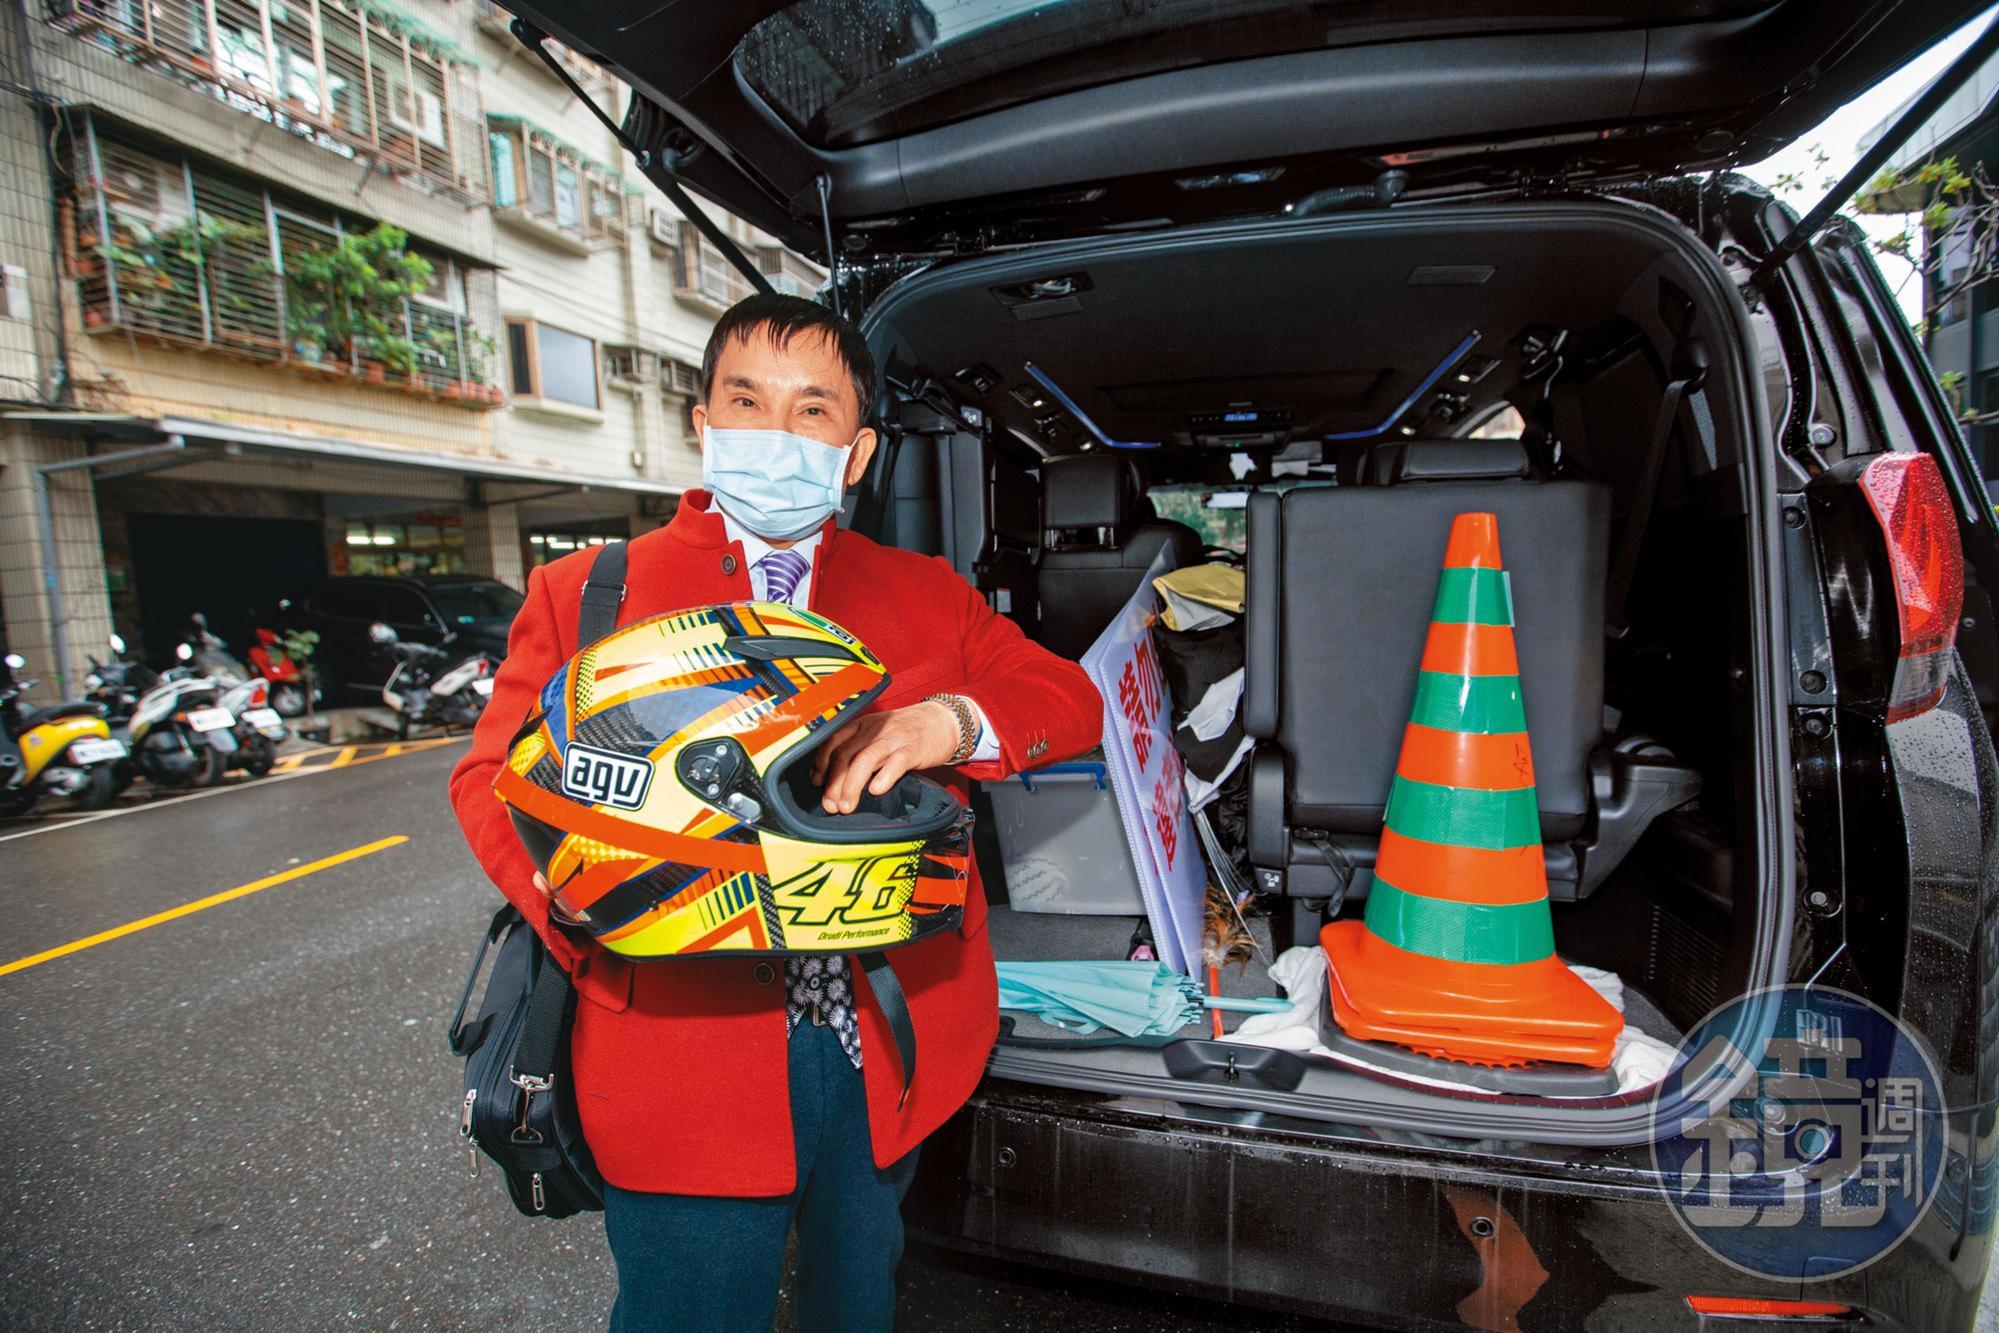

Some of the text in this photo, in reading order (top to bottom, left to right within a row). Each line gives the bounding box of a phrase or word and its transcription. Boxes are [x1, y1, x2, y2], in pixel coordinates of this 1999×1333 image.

[1118, 628, 1166, 775] 請勿
[571, 756, 641, 802] agv
[772, 853, 917, 926] 46
[817, 927, 890, 941] Drudi Performance
